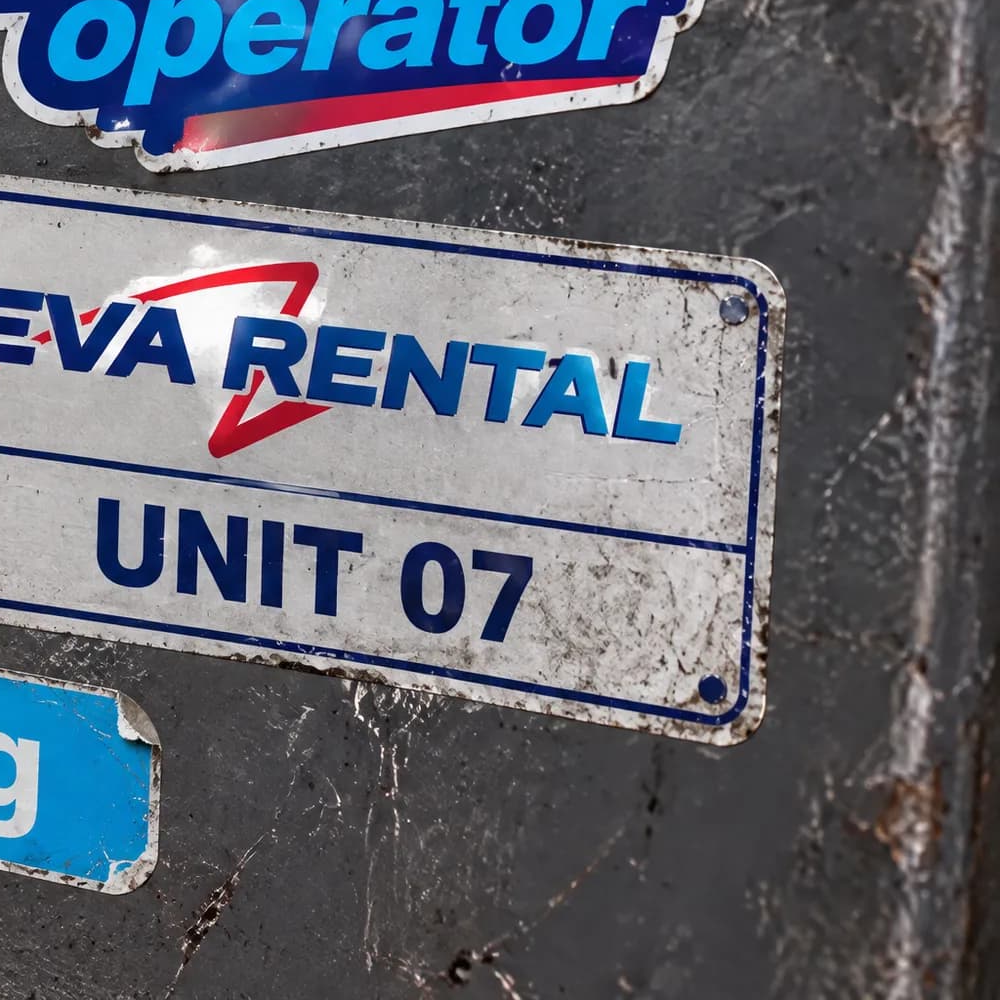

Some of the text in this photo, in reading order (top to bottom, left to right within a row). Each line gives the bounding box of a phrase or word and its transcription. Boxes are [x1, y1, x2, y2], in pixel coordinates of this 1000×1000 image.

[222, 315, 683, 445] RENTAL
[96, 497, 534, 643] UNIT 07
